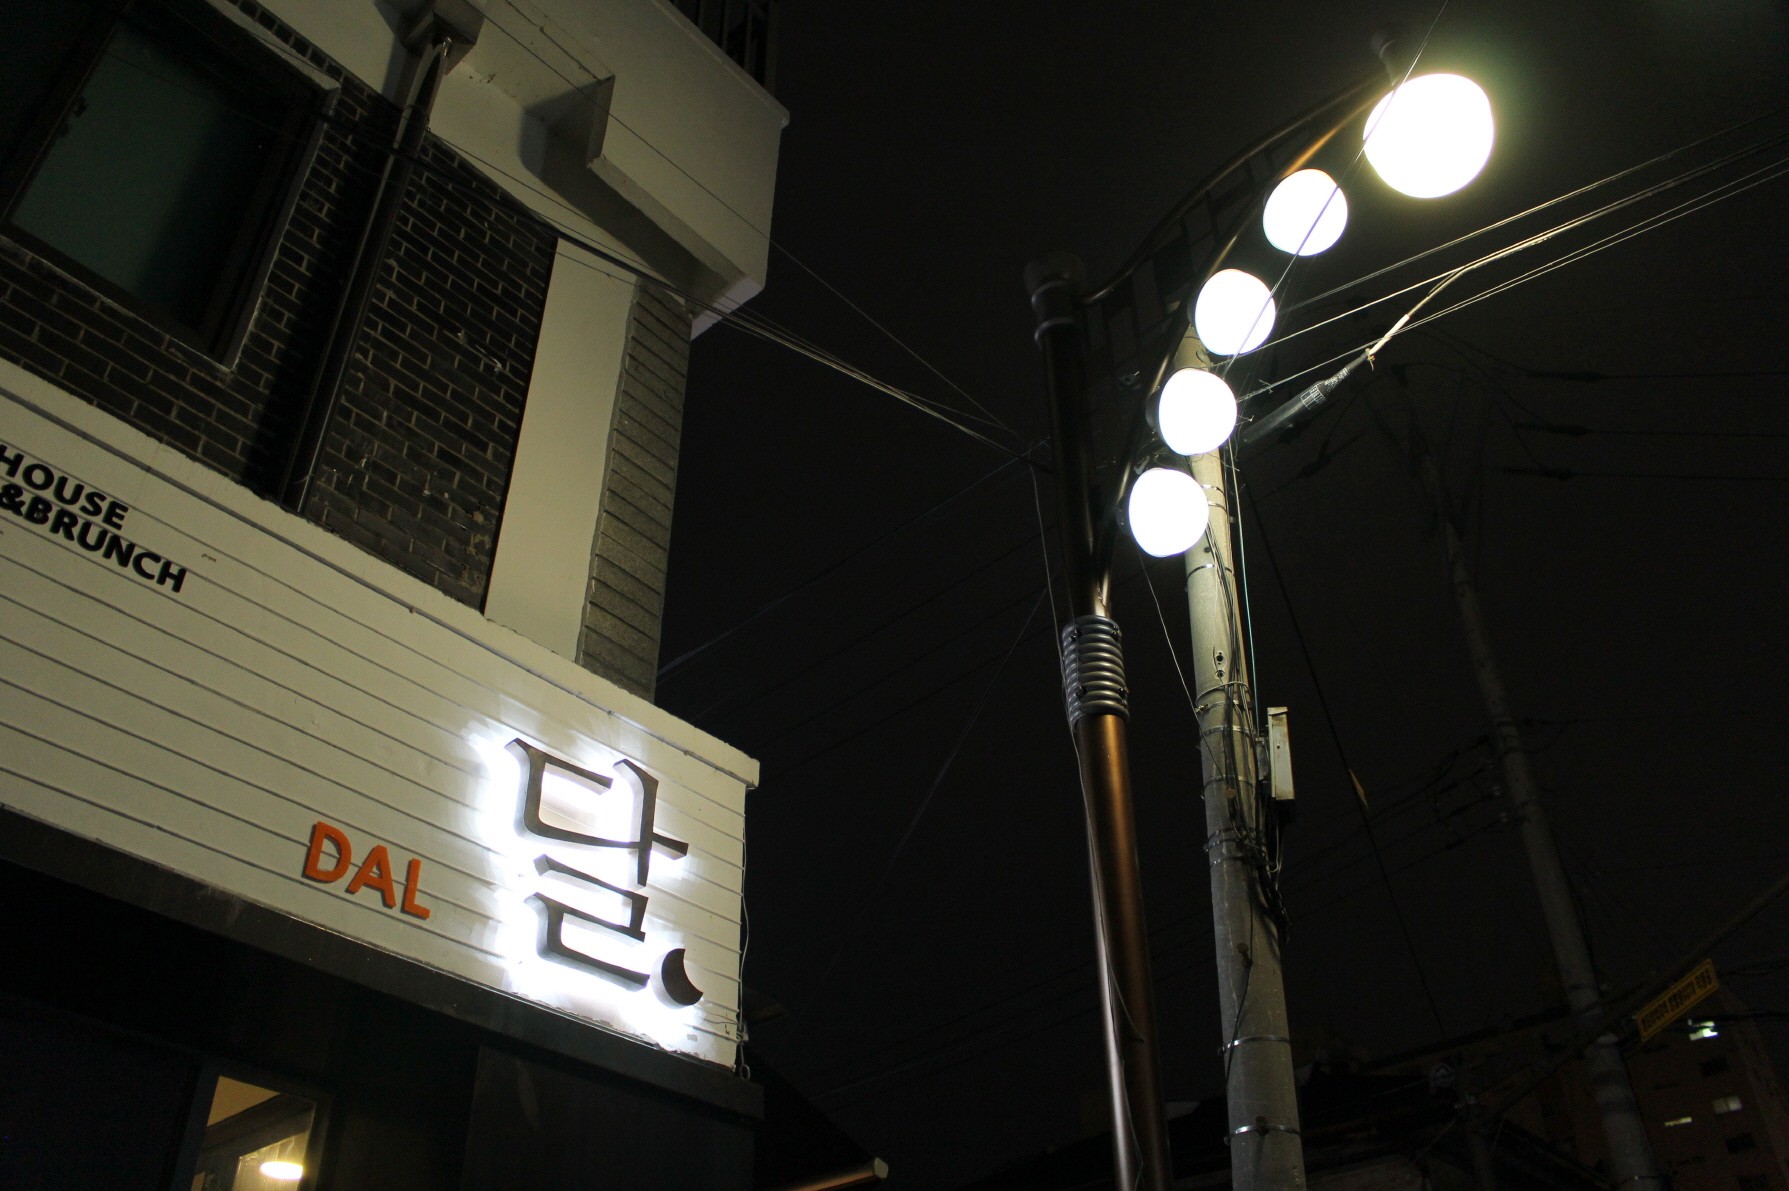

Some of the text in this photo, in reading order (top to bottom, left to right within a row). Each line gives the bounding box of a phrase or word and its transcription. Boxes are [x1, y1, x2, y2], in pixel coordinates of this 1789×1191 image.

[0, 444, 129, 531] HOUSE
[303, 821, 431, 920] DAL
[504, 737, 689, 992] 달
